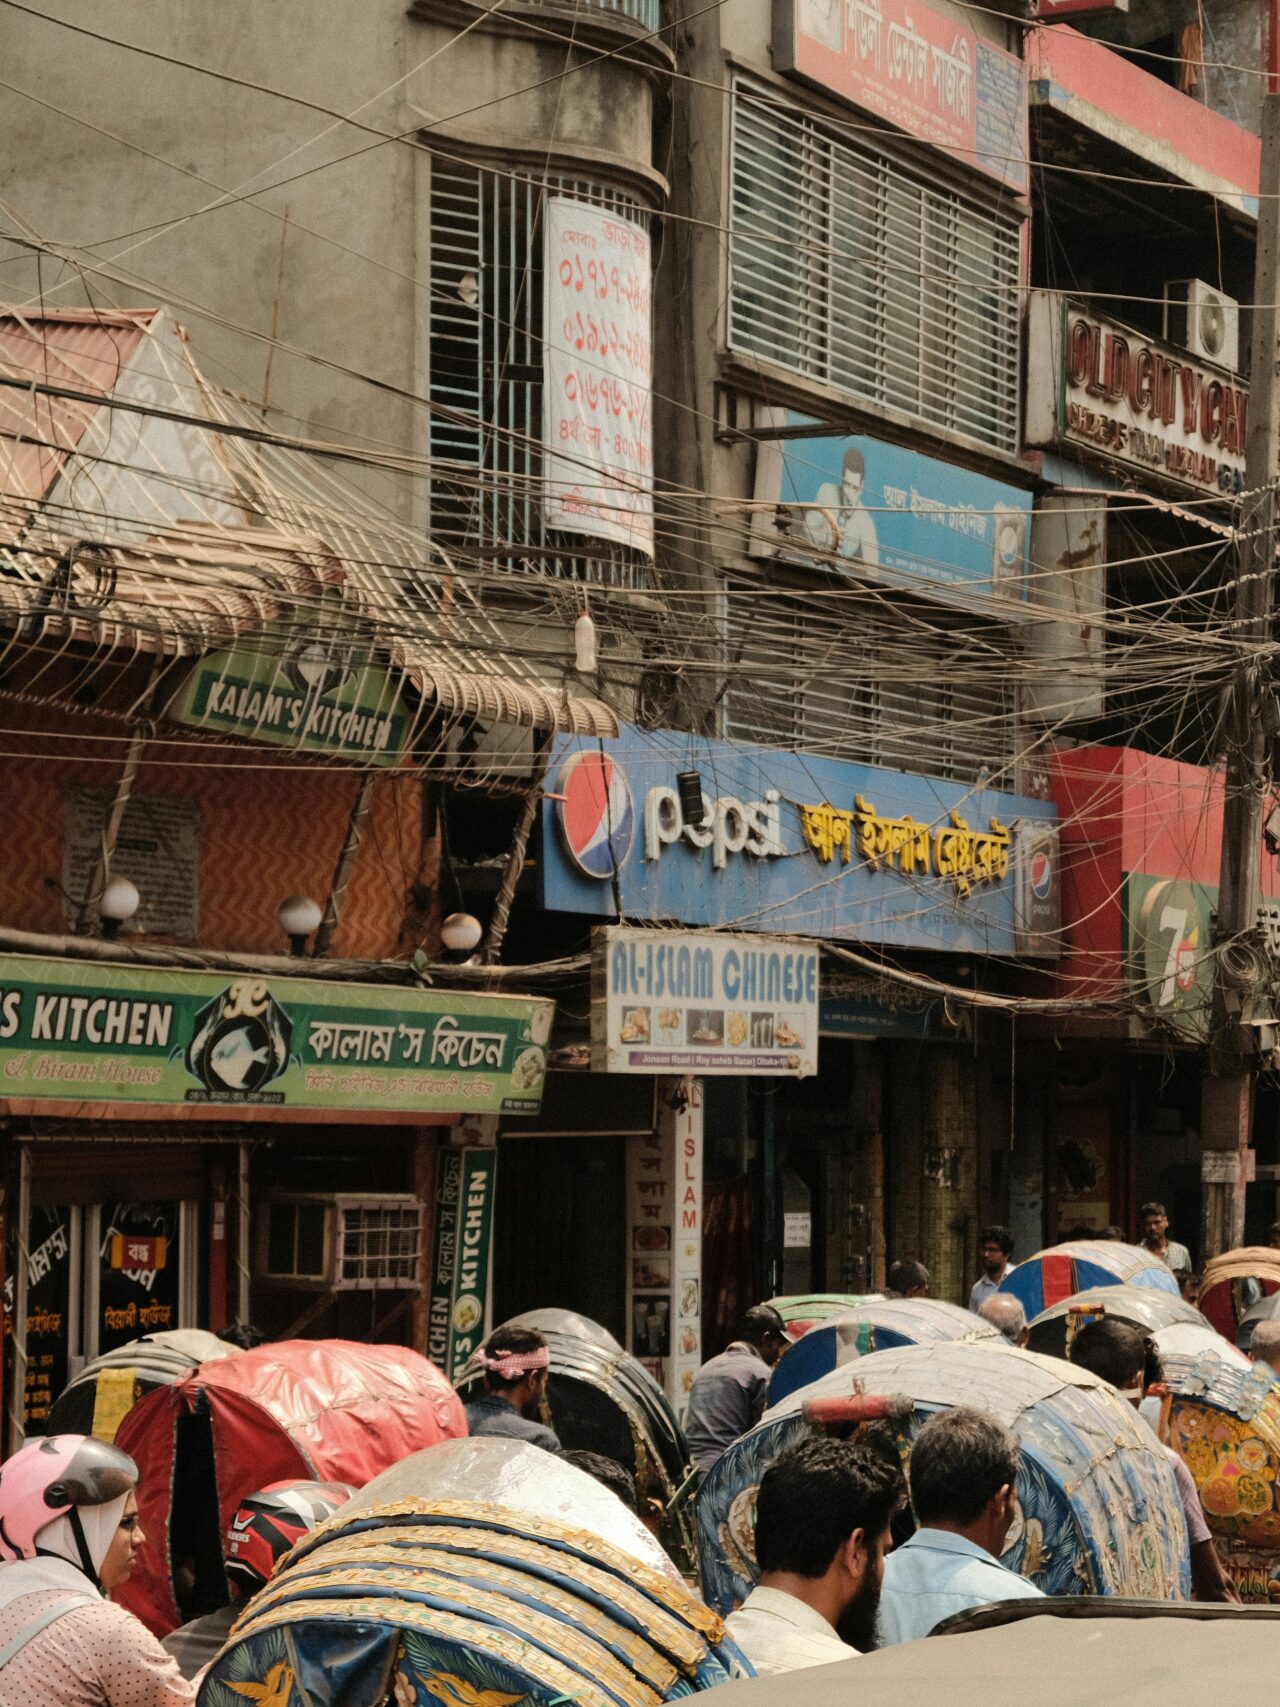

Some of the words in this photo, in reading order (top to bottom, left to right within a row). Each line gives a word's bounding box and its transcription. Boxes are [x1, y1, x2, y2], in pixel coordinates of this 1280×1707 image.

[1067, 318, 1131, 402] OLD
[1130, 345, 1204, 435] CITY
[205, 681, 302, 728] KALAM'S
[304, 704, 392, 750] KITCHEN
[801, 802, 853, 866] আল
[855, 792, 932, 877] ইসলাম
[611, 941, 714, 999] AL-ISLAM
[722, 950, 817, 1004] CHINESE
[31, 995, 173, 1047] KITCHEN
[430, 1015, 508, 1069] কিচেন
[33, 1056, 97, 1082] Birani
[99, 1058, 162, 1085] House
[641, 1055, 670, 1065] Jonson
[671, 1056, 691, 1065] Road
[128, 1244, 150, 1263] বন্ধ
[460, 1170, 488, 1290] KITCHEN
